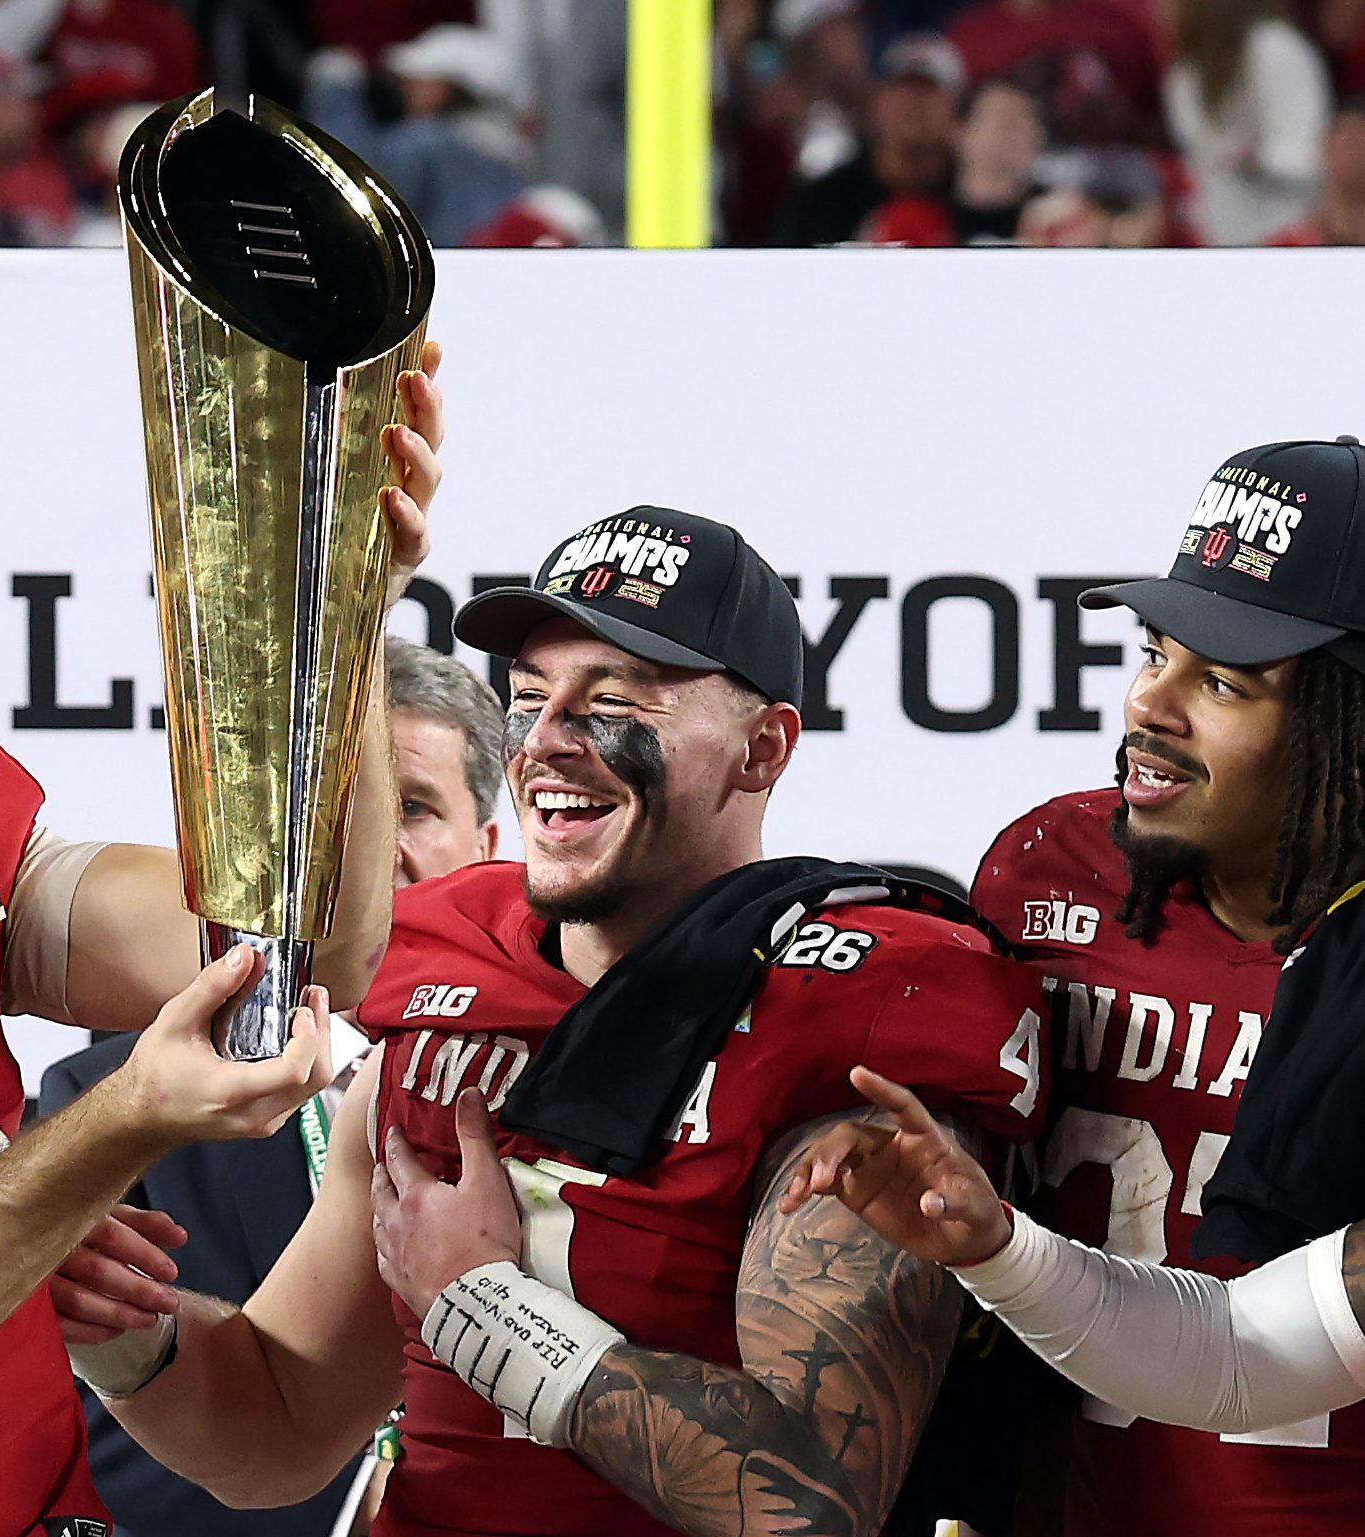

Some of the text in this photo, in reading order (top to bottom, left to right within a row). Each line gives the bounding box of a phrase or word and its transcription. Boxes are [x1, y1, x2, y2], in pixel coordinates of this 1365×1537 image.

[584, 518, 674, 543] NATIONAL
[548, 531, 690, 587] CHAMPS
[781, 922, 873, 971] 26
[1042, 976, 1263, 1098] NDIA
[518, 1303, 580, 1355] ISAIAH
[533, 1340, 569, 1370] RIP
